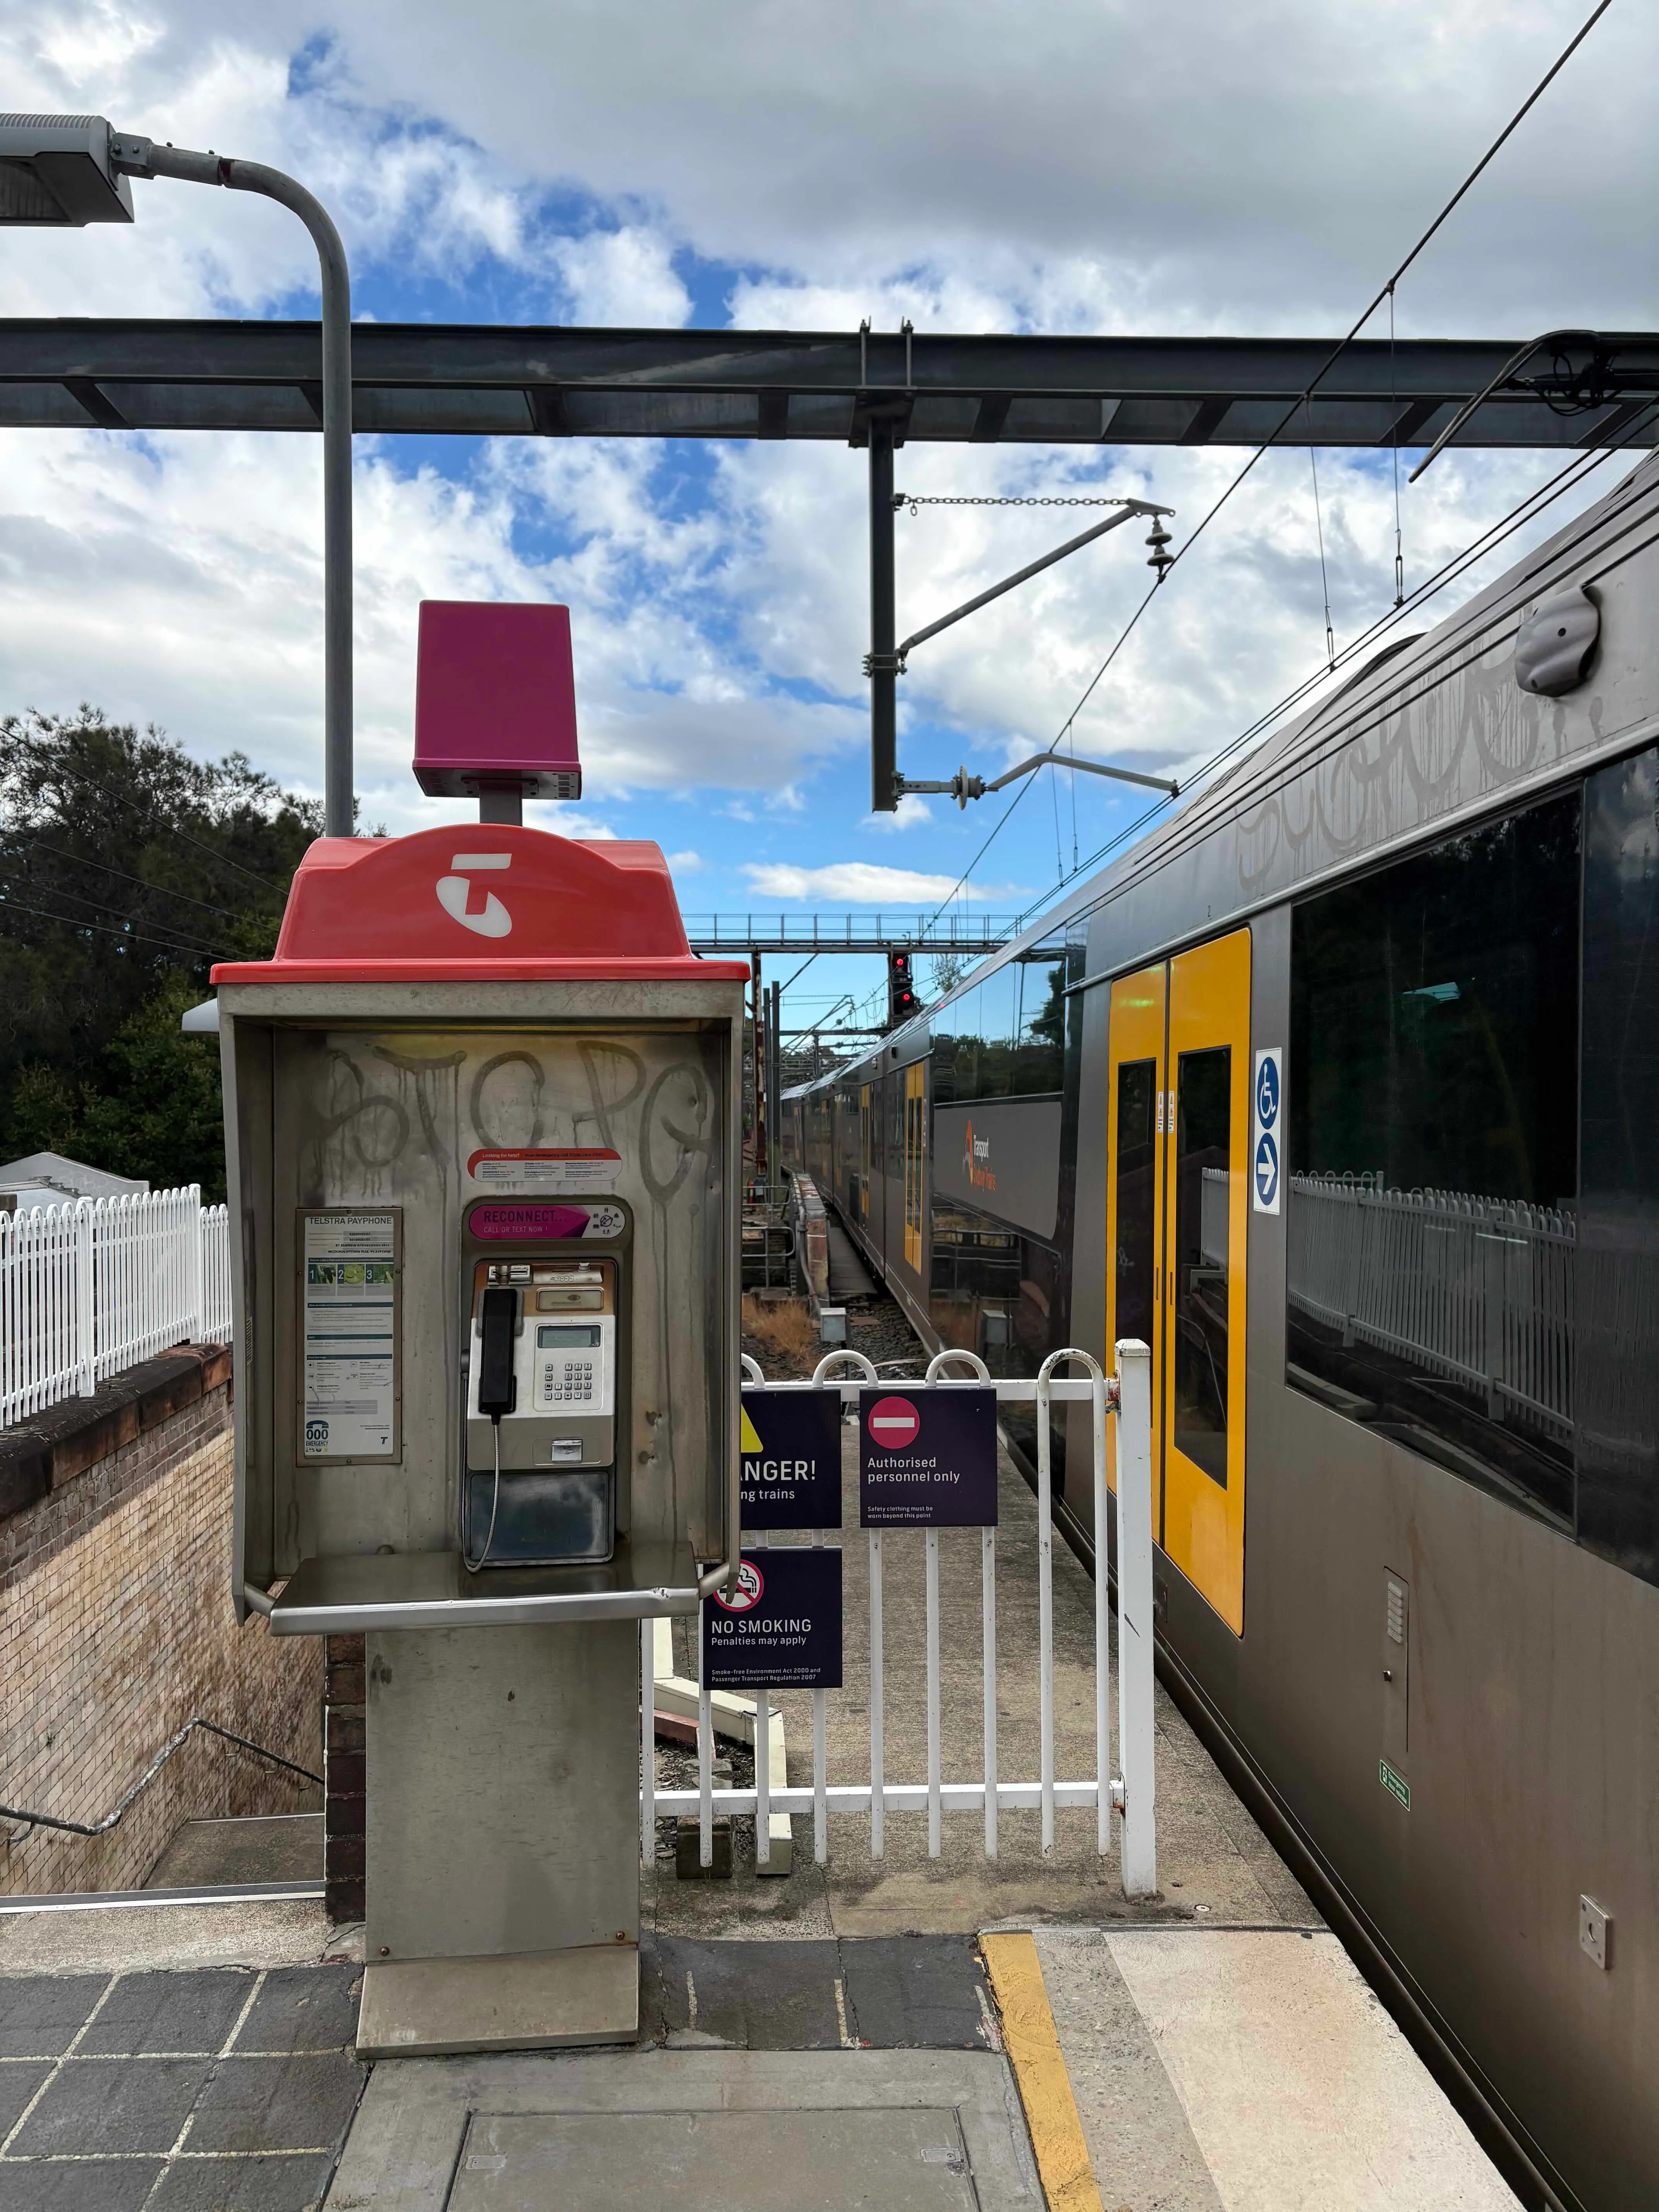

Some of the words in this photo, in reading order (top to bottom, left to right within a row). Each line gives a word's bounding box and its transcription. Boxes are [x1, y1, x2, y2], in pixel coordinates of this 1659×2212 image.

[974, 1135, 989, 1162] Transport
[310, 1270, 314, 1279] 1
[338, 1270, 344, 1279] 2
[367, 1270, 372, 1279] 3
[306, 1429, 328, 1440] 000
[867, 1457, 936, 1468] Authorised
[740, 1460, 815, 1481] NGER!
[868, 1471, 929, 1484] personnel
[934, 1471, 960, 1484] only
[759, 1488, 795, 1499] trains
[712, 1620, 733, 1633] NO
[738, 1619, 811, 1633] SMOKING
[711, 1637, 756, 1645] Penalties
[758, 1638, 778, 1646] may
[780, 1635, 806, 1646] apply
